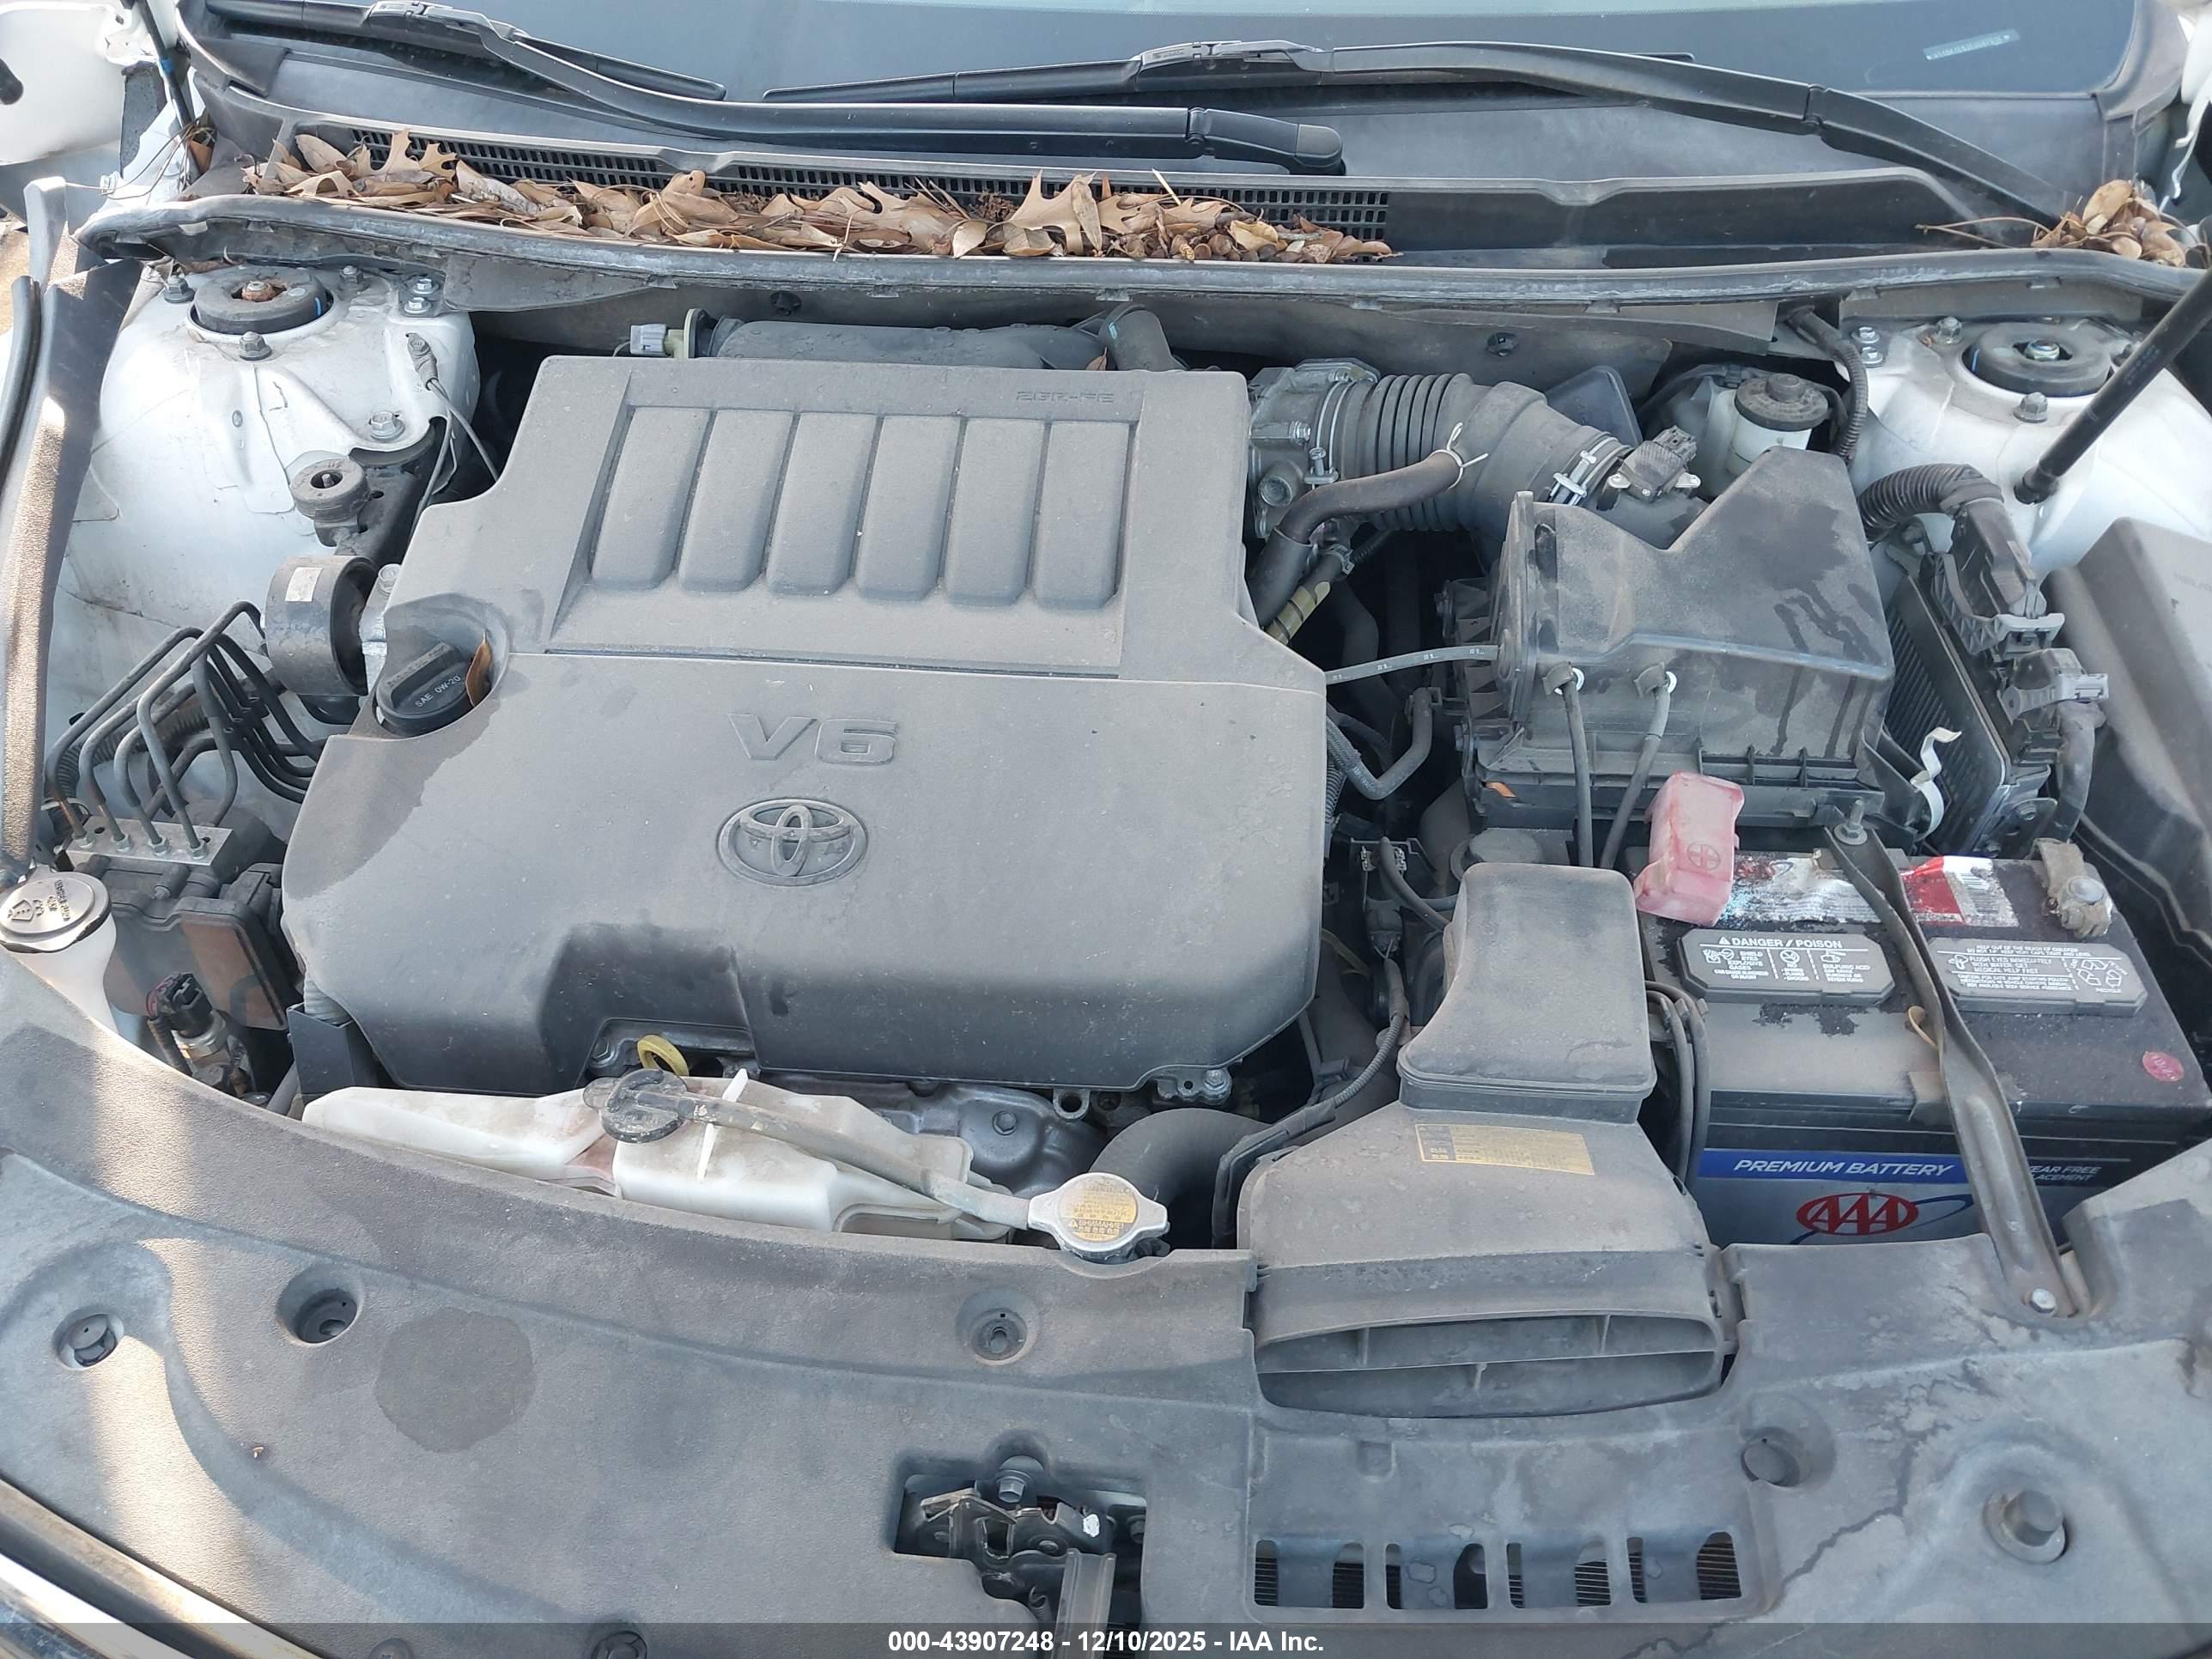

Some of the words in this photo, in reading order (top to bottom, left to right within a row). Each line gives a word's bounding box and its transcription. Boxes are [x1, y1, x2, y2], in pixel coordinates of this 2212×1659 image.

[415, 693, 434, 708] SAE
[434, 674, 461, 693] 0W-20
[727, 713, 900, 766] V6
[1731, 937, 1784, 947] DANGER
[1796, 939, 1843, 949] POISON
[1734, 1159, 1844, 1174] PREMIUM
[1845, 1162, 1954, 1176] BATTERY
[1803, 1193, 1917, 1235] AAA
